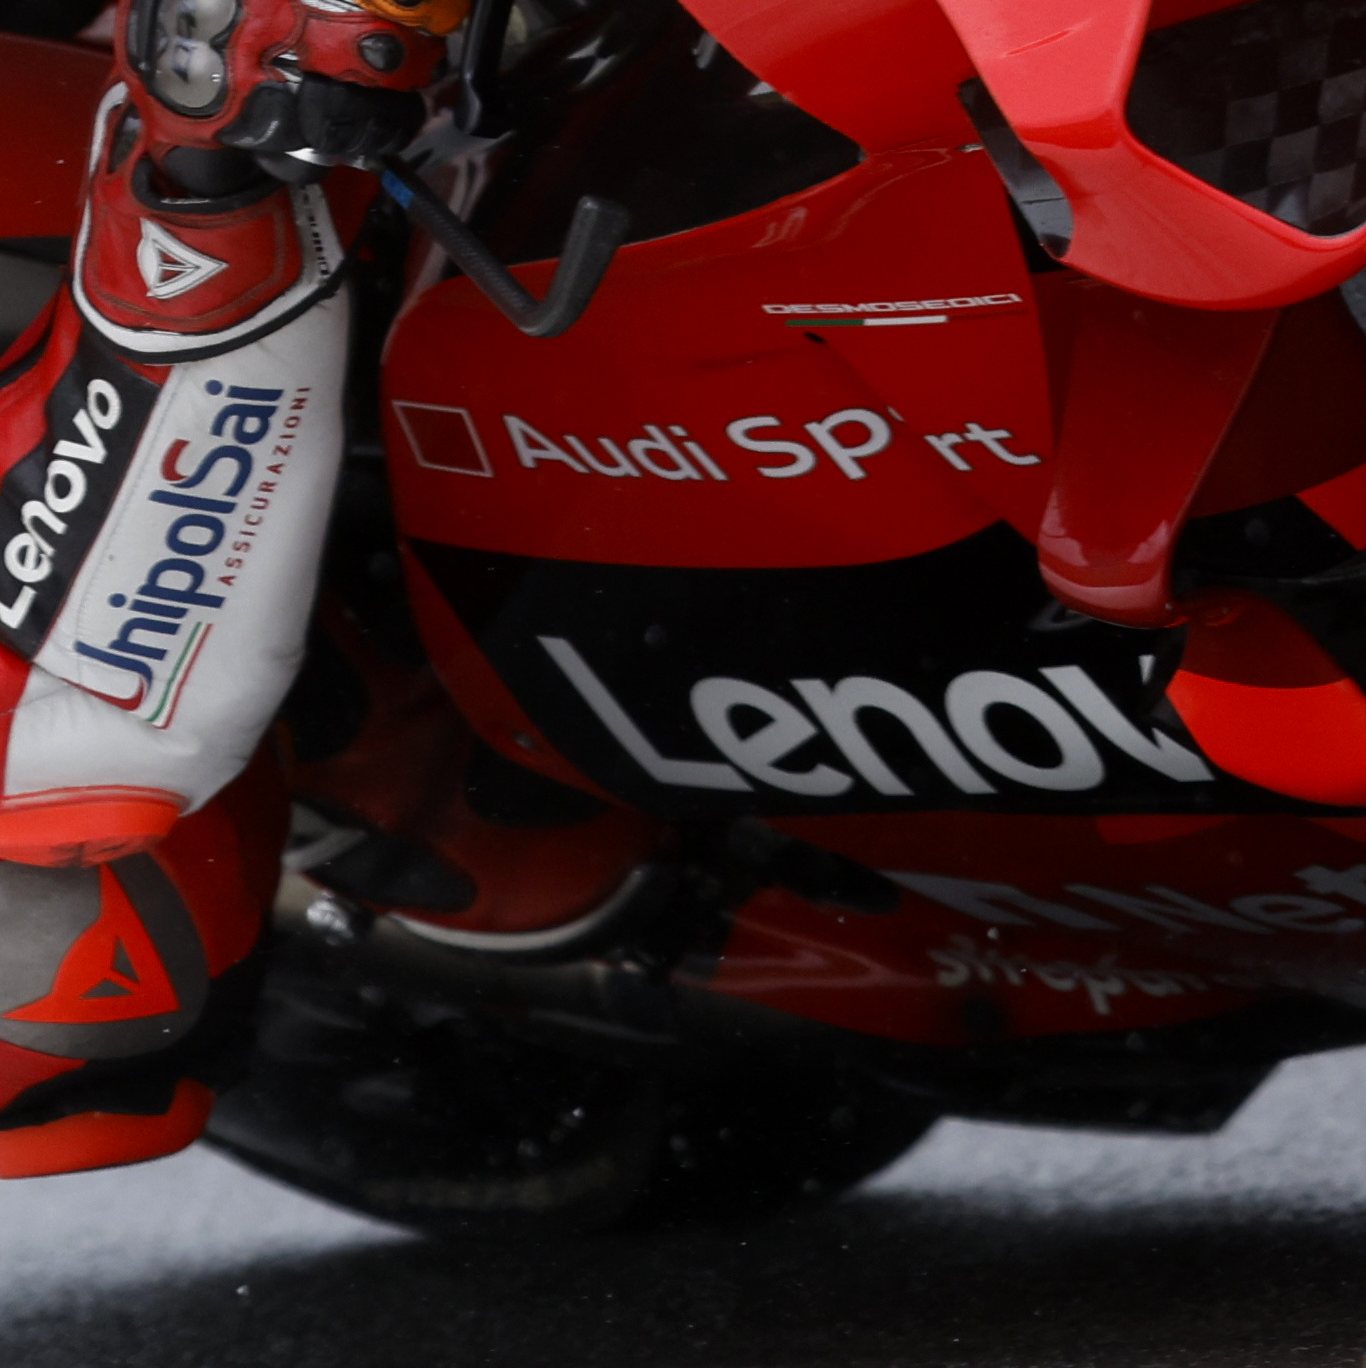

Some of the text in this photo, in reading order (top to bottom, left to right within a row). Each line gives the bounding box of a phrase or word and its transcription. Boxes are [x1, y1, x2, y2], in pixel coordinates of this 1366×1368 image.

[761, 292, 1024, 316] DESMOSEDICI
[218, 386, 312, 587] ASSICURAZIONI
[501, 405, 1043, 482] Audi Sprt
[74, 377, 286, 711] UnipolSai
